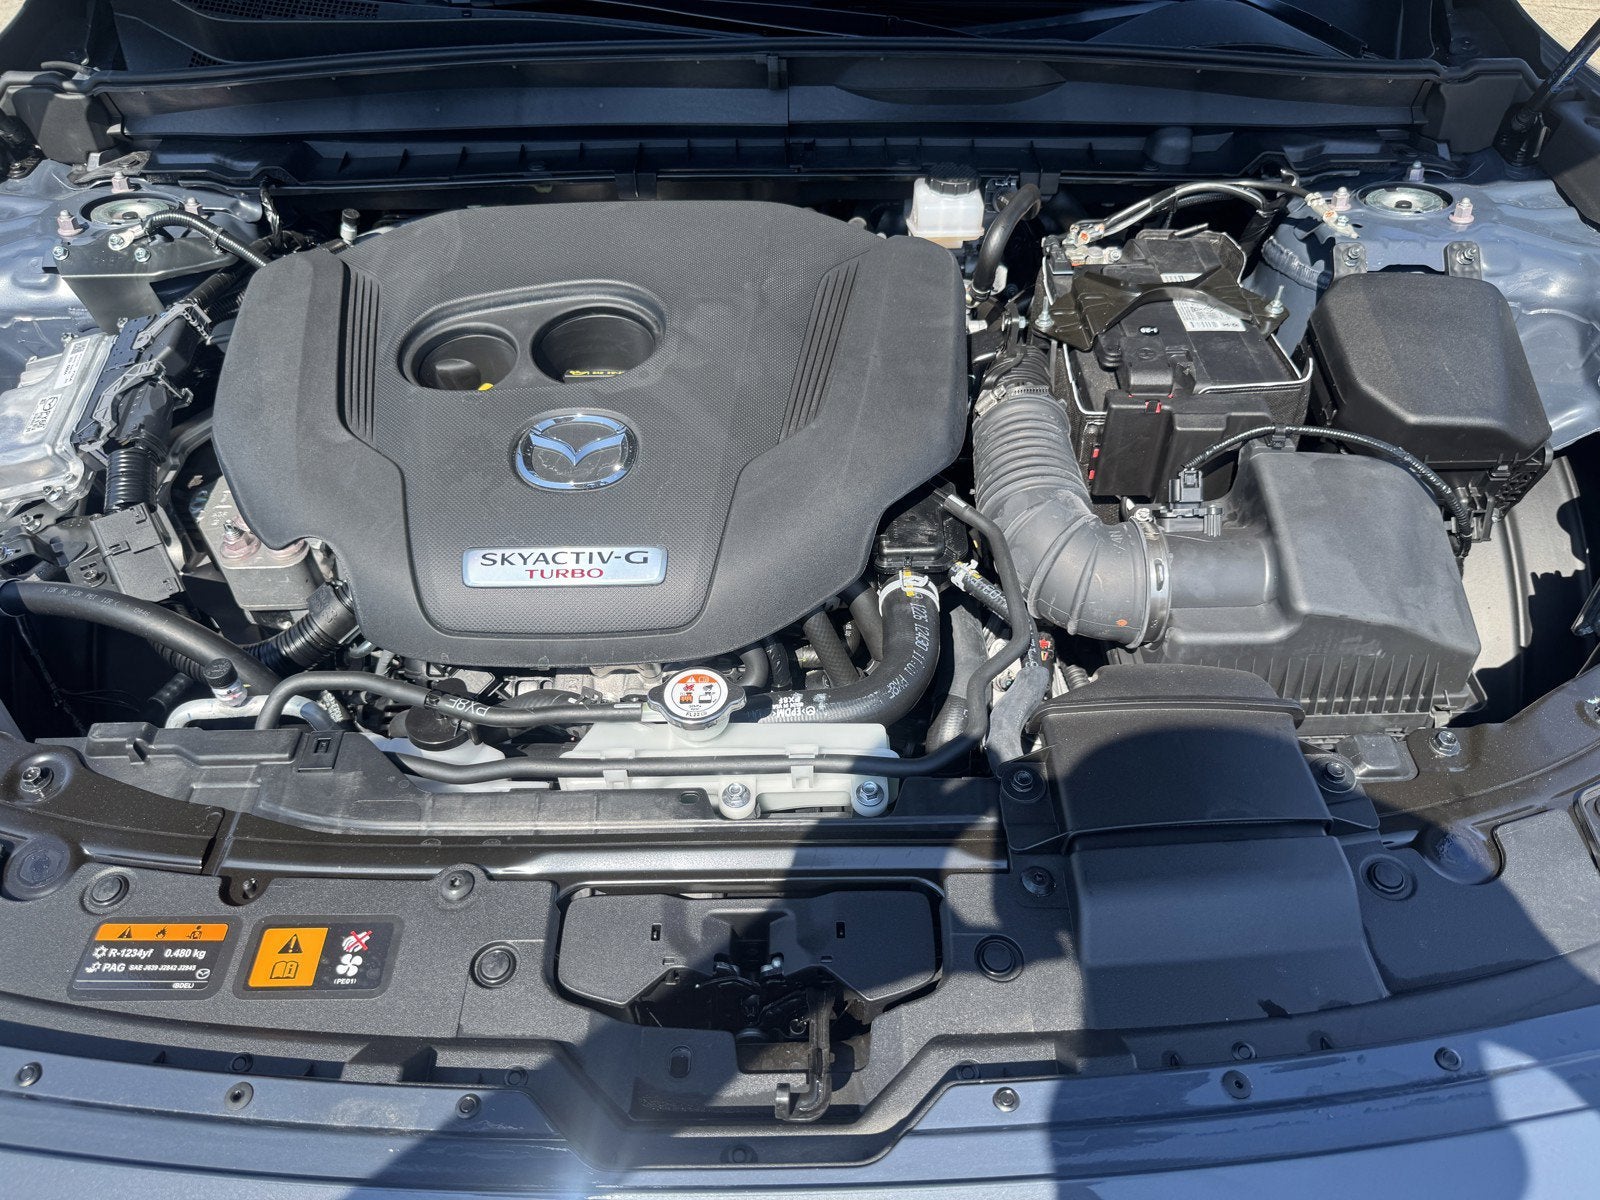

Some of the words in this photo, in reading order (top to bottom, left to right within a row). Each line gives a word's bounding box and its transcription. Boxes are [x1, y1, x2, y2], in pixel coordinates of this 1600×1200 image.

[480, 550, 649, 567] SKYACTIV-G
[525, 568, 604, 580] TURBO
[108, 948, 154, 960] R-1234yf
[164, 949, 191, 958] 0.480
[192, 949, 206, 960] kg
[102, 963, 126, 973] PAG
